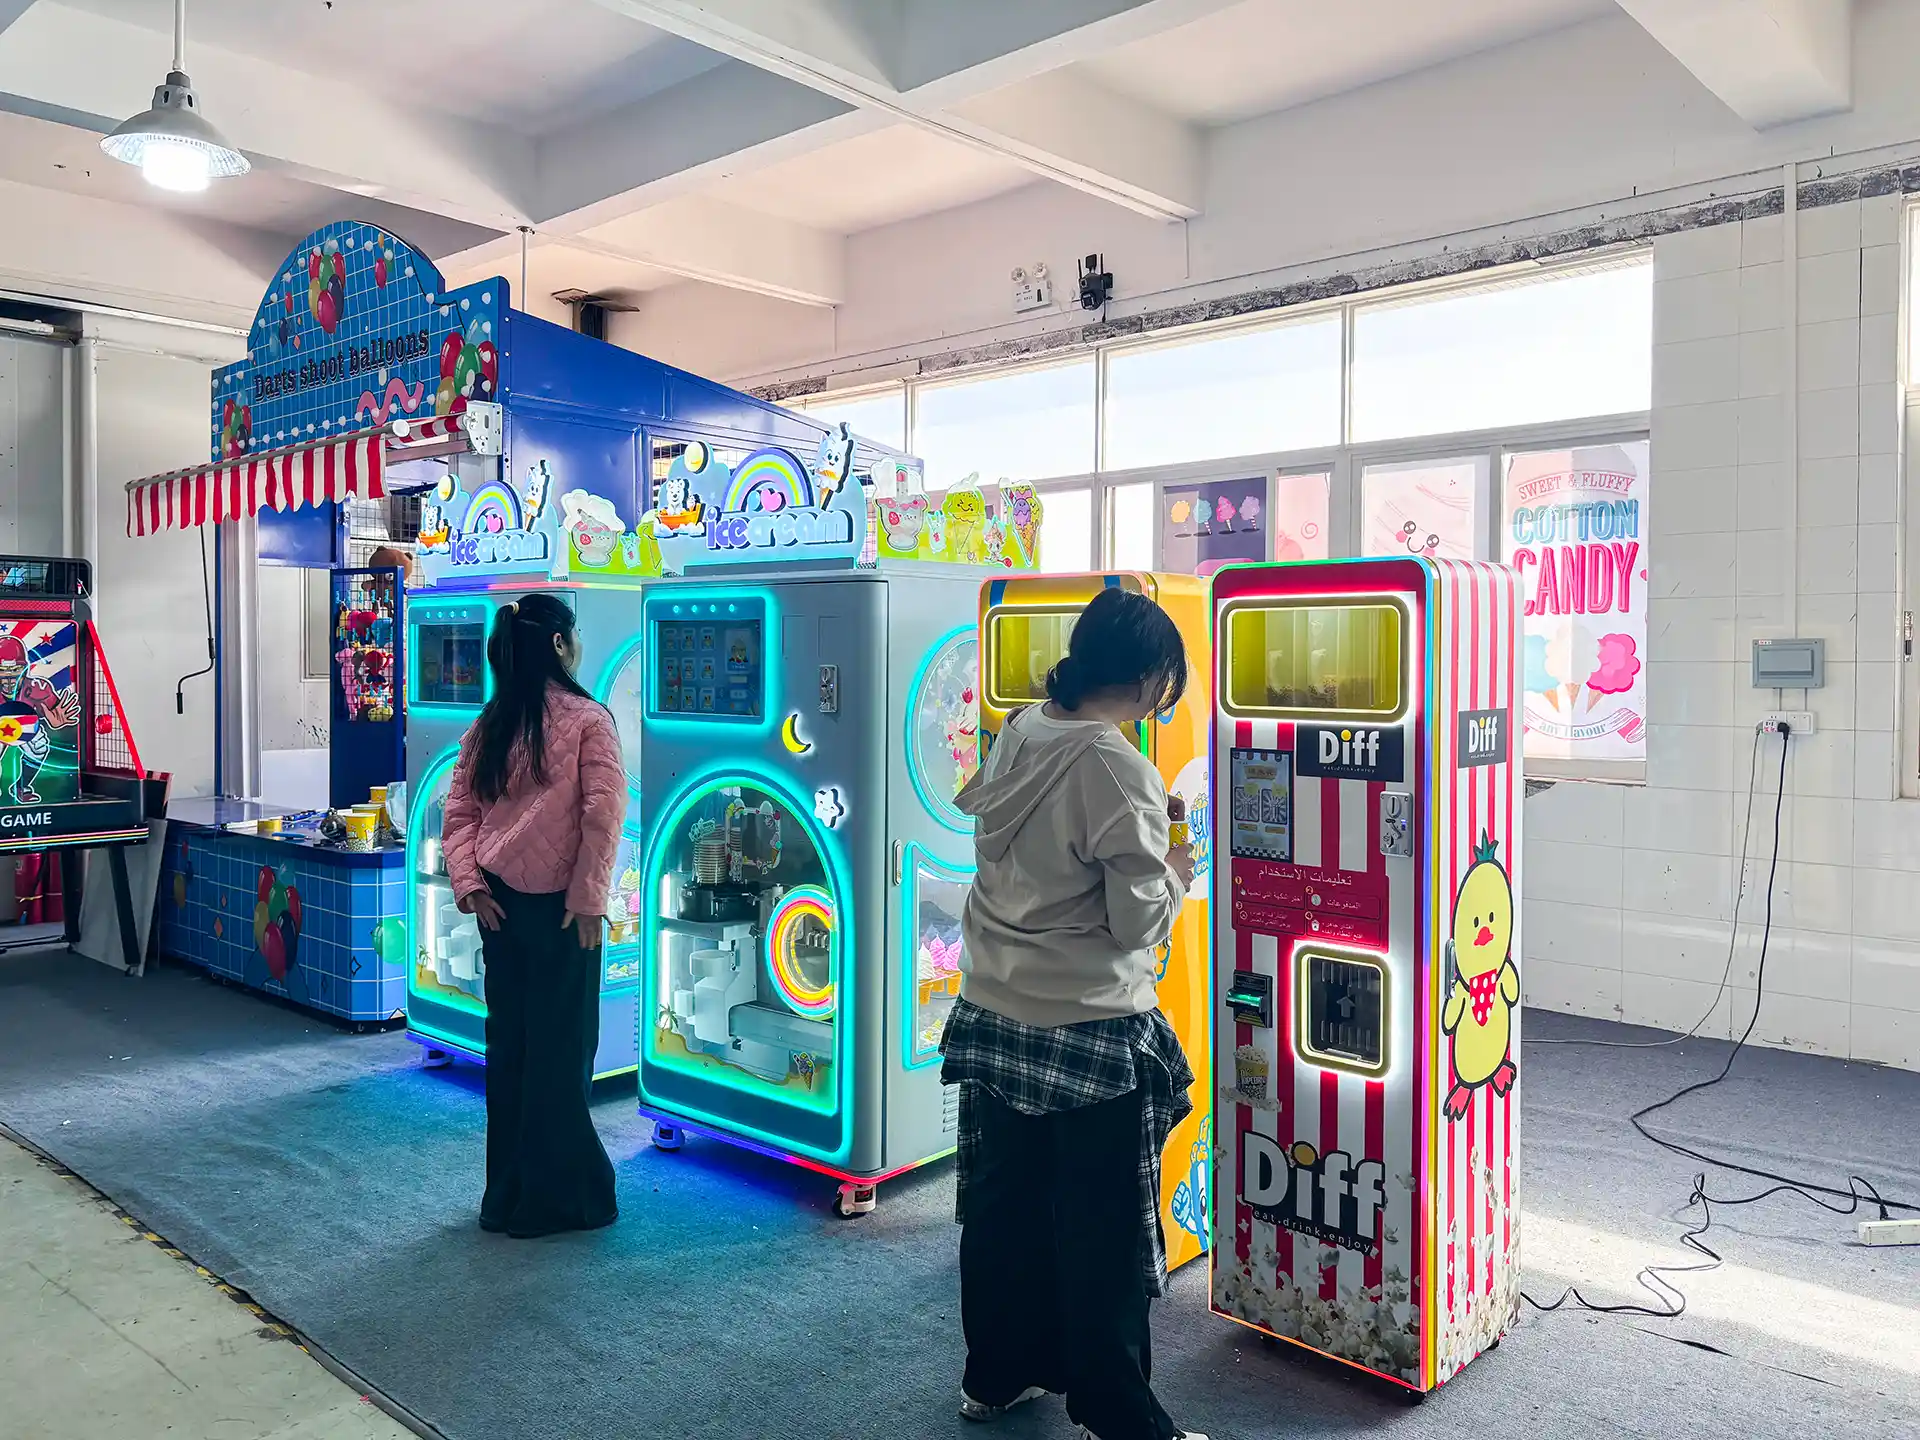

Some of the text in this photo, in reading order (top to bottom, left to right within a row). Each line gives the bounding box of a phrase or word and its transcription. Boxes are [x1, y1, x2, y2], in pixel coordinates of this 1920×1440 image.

[254, 329, 429, 402] Darts shoot balloons
[1518, 475, 1562, 500] SWEET
[1582, 472, 1635, 492] FLUFFY
[1512, 499, 1640, 545] COTTON
[1512, 541, 1640, 616] CANDY
[1318, 729, 1380, 766] Diff
[1468, 715, 1498, 753] Diff
[0, 812, 52, 828] GAME
[1257, 864, 1352, 887] تعليمات الاستخدام
[1244, 1131, 1383, 1240] Diff
[1253, 1209, 1371, 1253] eat.drink.enjoy
